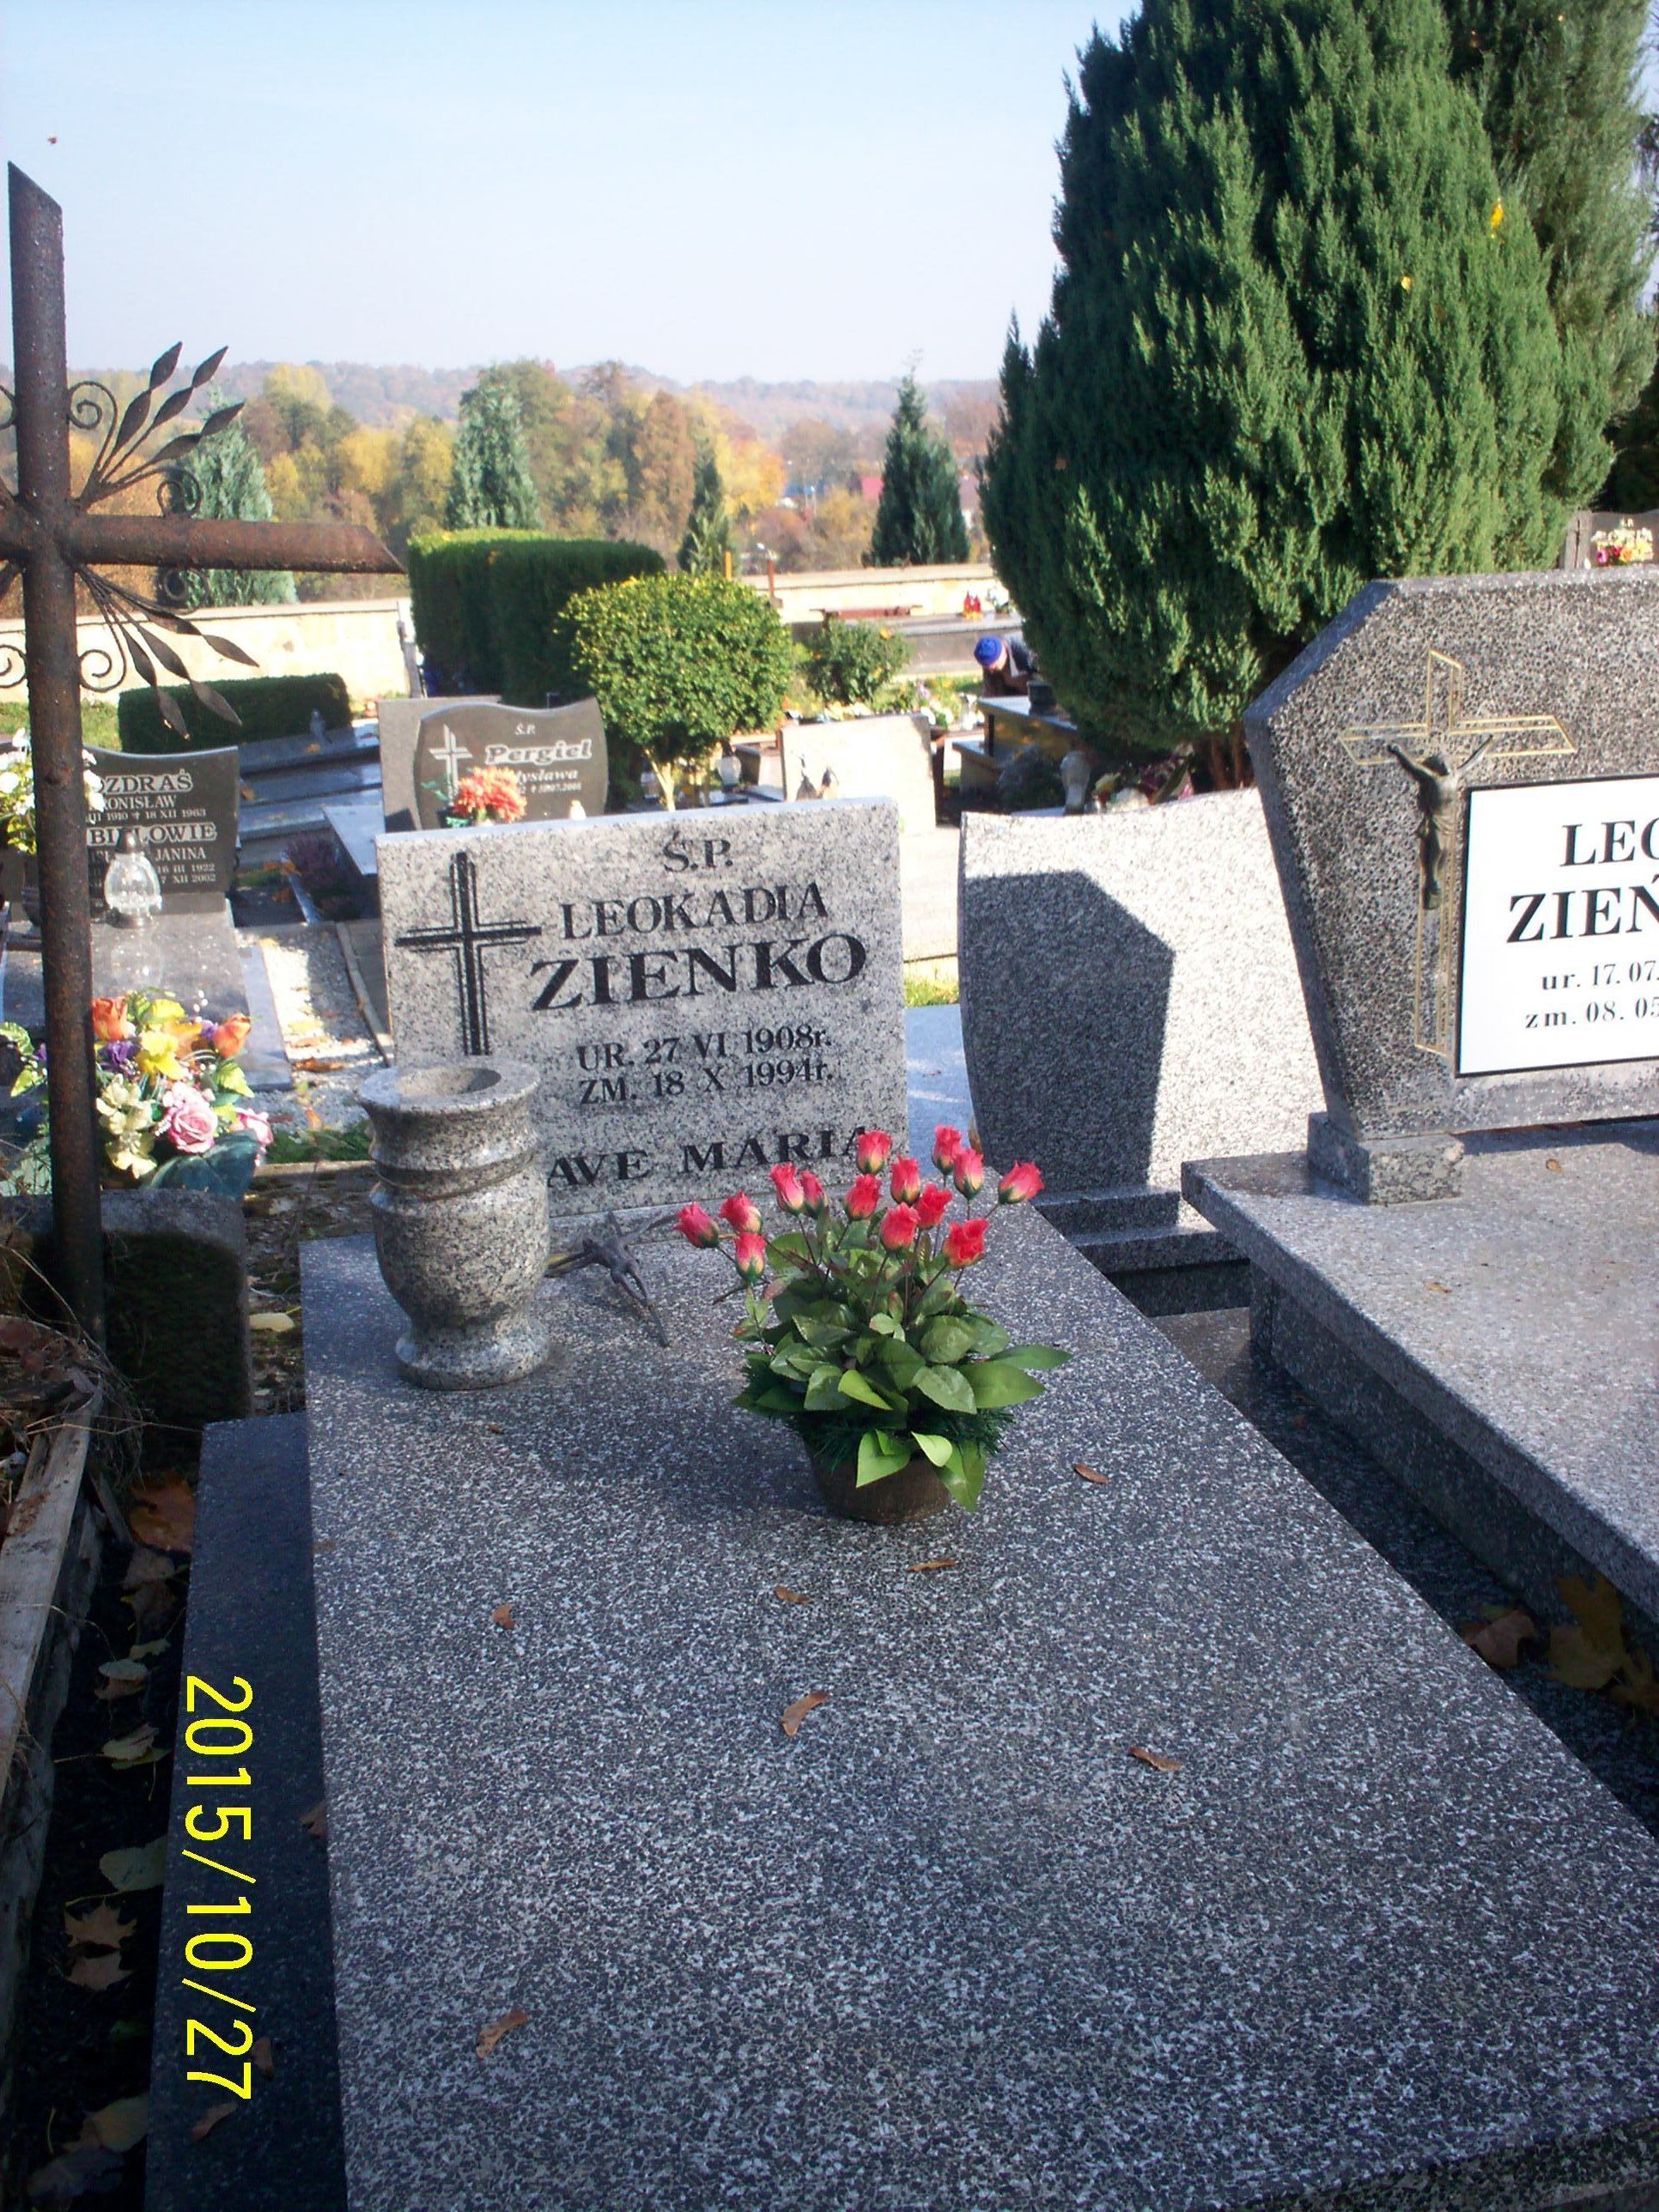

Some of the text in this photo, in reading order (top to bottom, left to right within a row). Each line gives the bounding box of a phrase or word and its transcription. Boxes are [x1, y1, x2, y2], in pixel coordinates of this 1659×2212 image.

[485, 739, 592, 766] Pergiel
[155, 847, 207, 861] JANINA
[663, 830, 733, 872] Ś.P.
[562, 882, 828, 939] LEOKADIA
[530, 933, 867, 1012] ZIENKO
[1541, 973, 1581, 990] ur.
[1525, 1010, 1577, 1029] zm.
[576, 1023, 832, 1072] UR. 27 VI 1908r.
[579, 1056, 834, 1105] ZM. 18 X 1994r.
[547, 1150, 648, 1188] AVE
